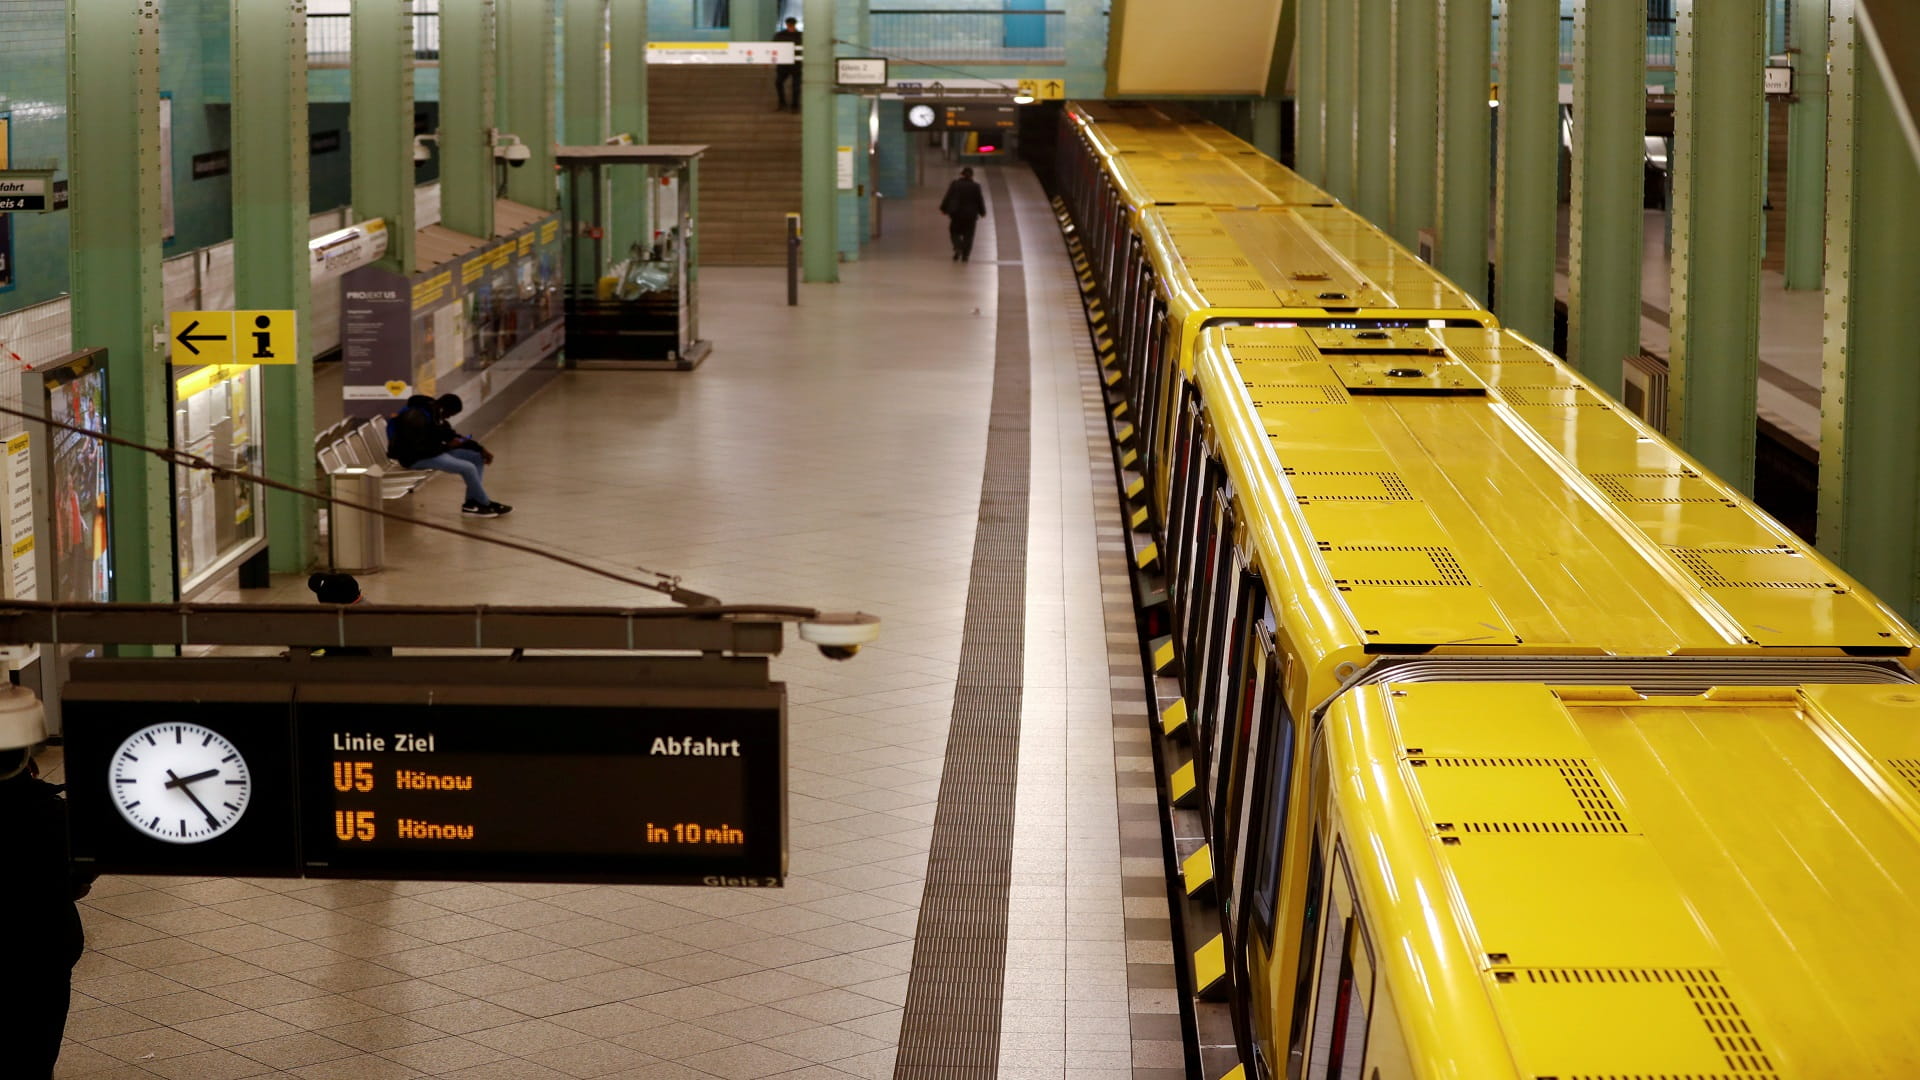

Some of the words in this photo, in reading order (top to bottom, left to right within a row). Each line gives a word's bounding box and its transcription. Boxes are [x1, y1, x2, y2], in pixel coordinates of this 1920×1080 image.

[17, 198, 24, 208] 4
[333, 733, 386, 751] Linie
[394, 733, 435, 752] Ziel
[650, 736, 741, 757] Abfahrt
[333, 761, 374, 792] U5
[396, 770, 473, 790] Hönow
[335, 810, 376, 841] U5
[397, 818, 474, 839] Hönow
[646, 822, 669, 843] in
[672, 823, 701, 843] 10
[704, 823, 744, 844] min
[703, 875, 759, 887] Gleis
[765, 876, 777, 887] 2
